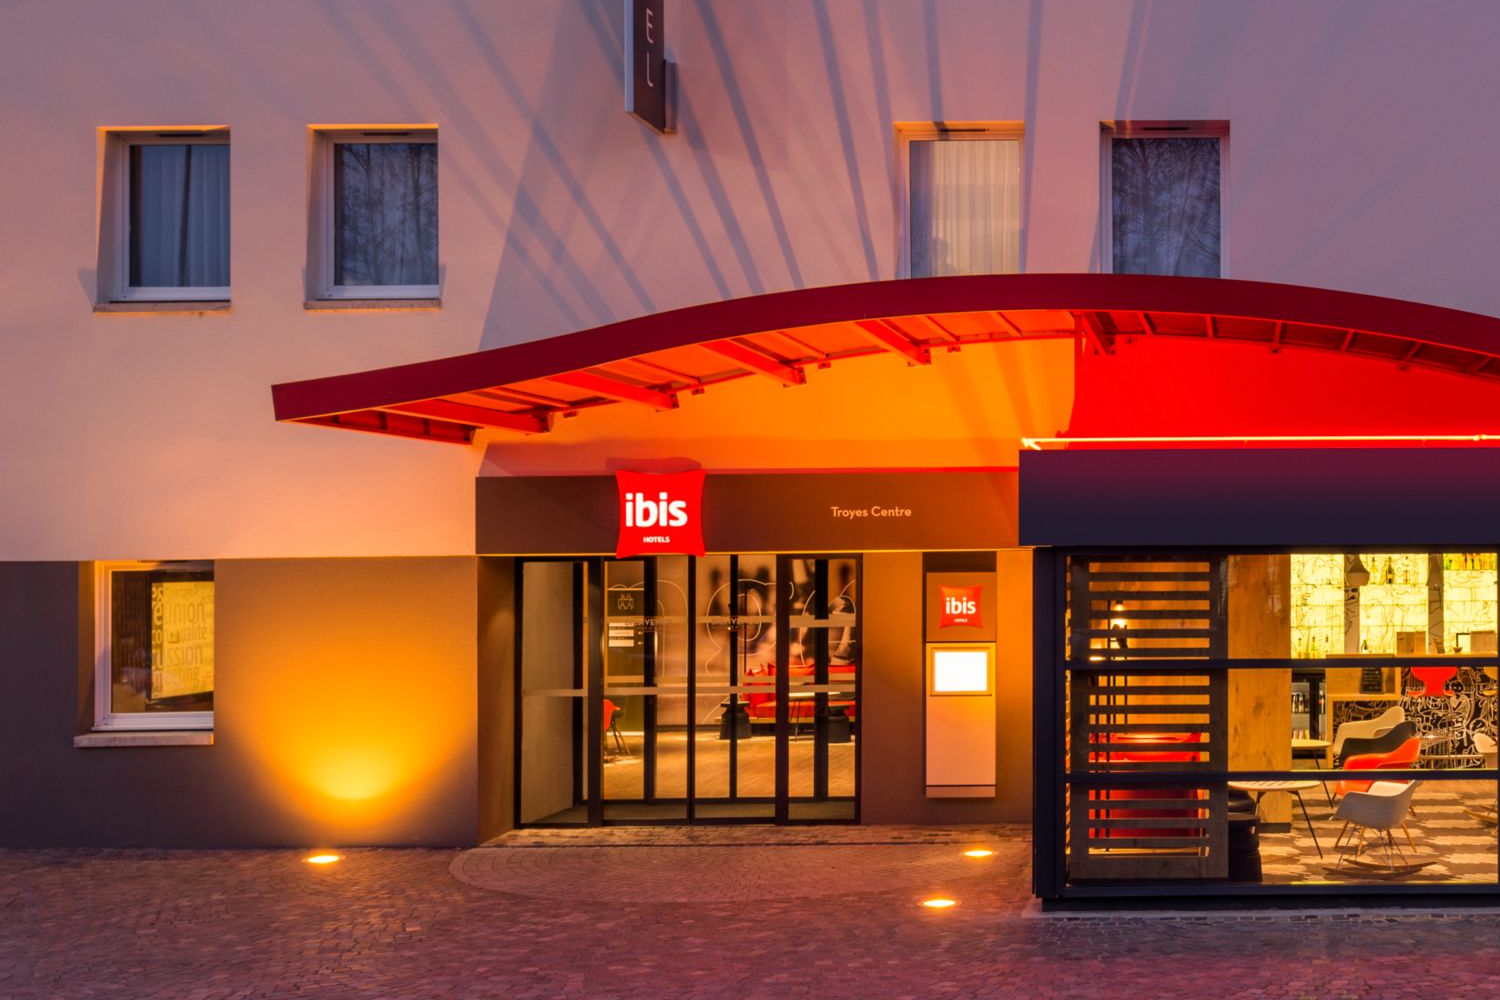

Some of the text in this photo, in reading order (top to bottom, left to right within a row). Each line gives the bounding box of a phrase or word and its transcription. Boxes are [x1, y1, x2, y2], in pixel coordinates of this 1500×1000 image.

[625, 492, 688, 527] ibis
[831, 505, 912, 520] Troyes Centre
[945, 596, 977, 615] ibis
